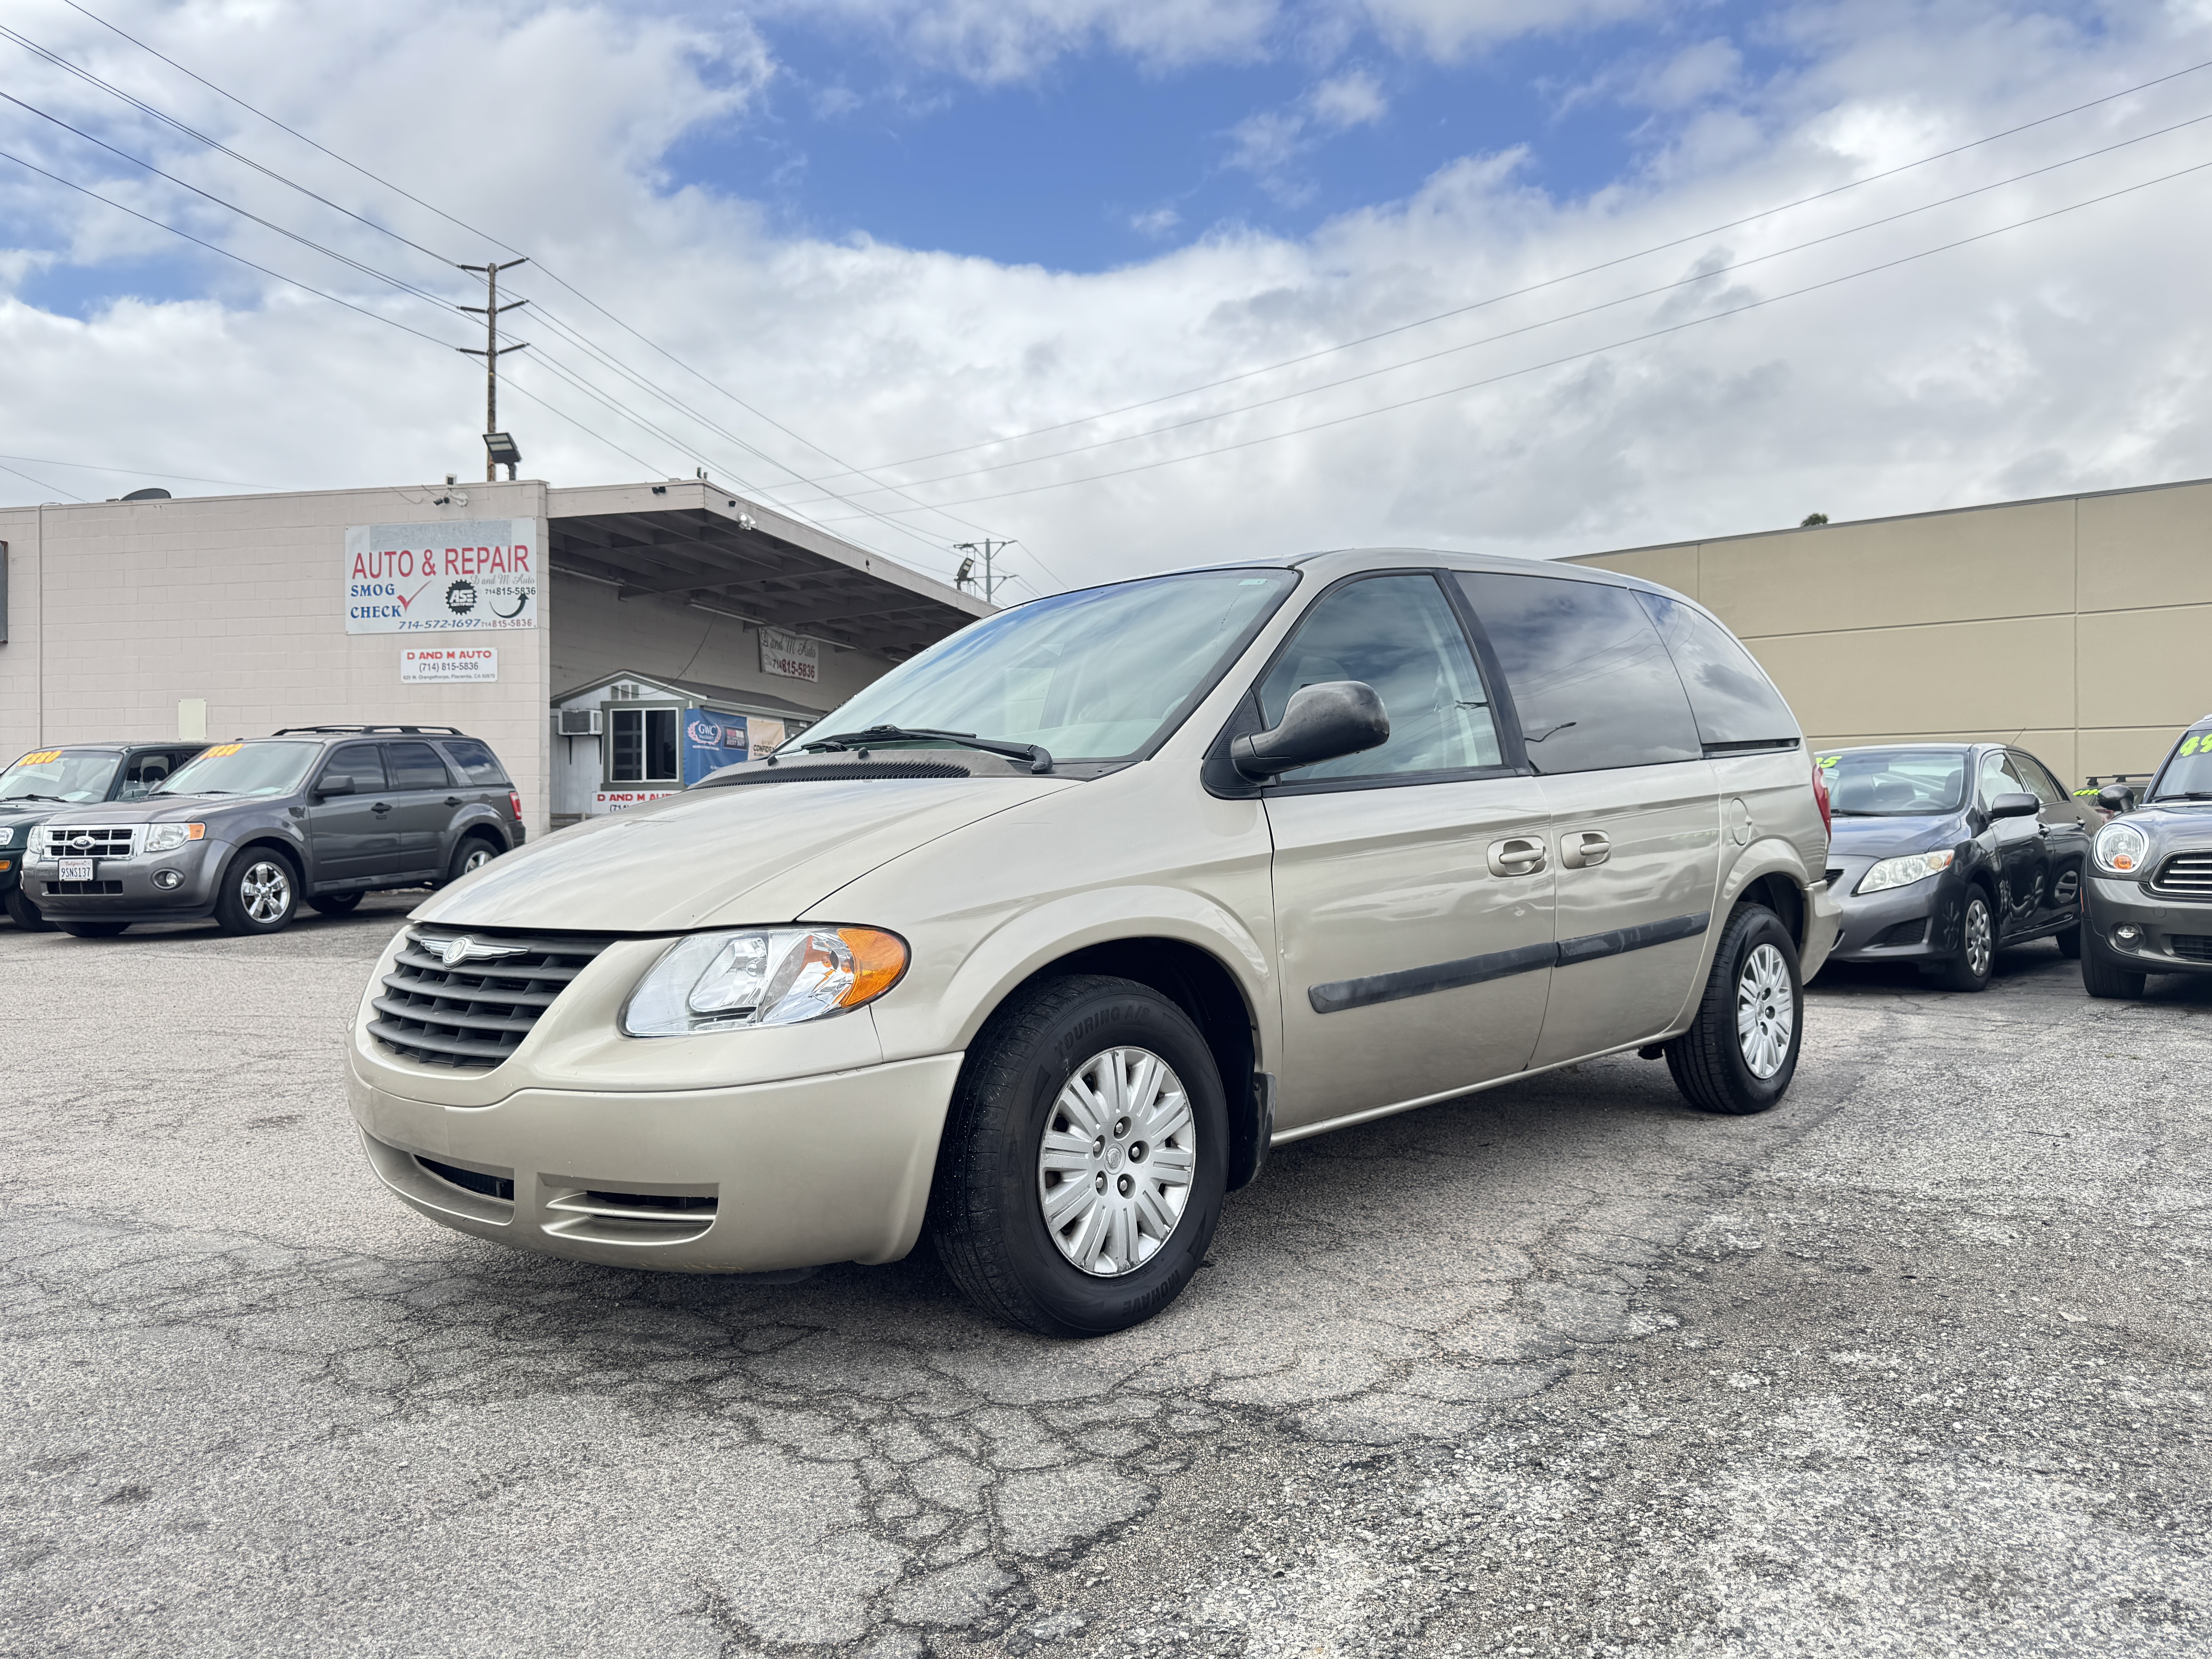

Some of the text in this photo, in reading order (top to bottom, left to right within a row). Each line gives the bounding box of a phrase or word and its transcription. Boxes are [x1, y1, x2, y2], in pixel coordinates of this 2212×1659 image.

[352, 545, 530, 579] AUTO & REPAIR
[470, 573, 535, 584] D and M Auto
[350, 584, 395, 597] SMOG
[449, 589, 474, 603] ASE
[350, 605, 402, 618] CHECK
[398, 619, 481, 630] 714-572-1697
[770, 634, 784, 651] and
[797, 639, 816, 659] Auto
[419, 651, 443, 660] AND
[447, 651, 455, 659] M
[459, 650, 492, 659] AUTO
[419, 662, 479, 673] (714) 815-5836
[698, 724, 716, 736] GWC
[61, 867, 90, 878] 9SNS137
[1054, 1005, 1151, 1059] TOURING A/S
[1121, 1269, 1181, 1318] MOHAVE
